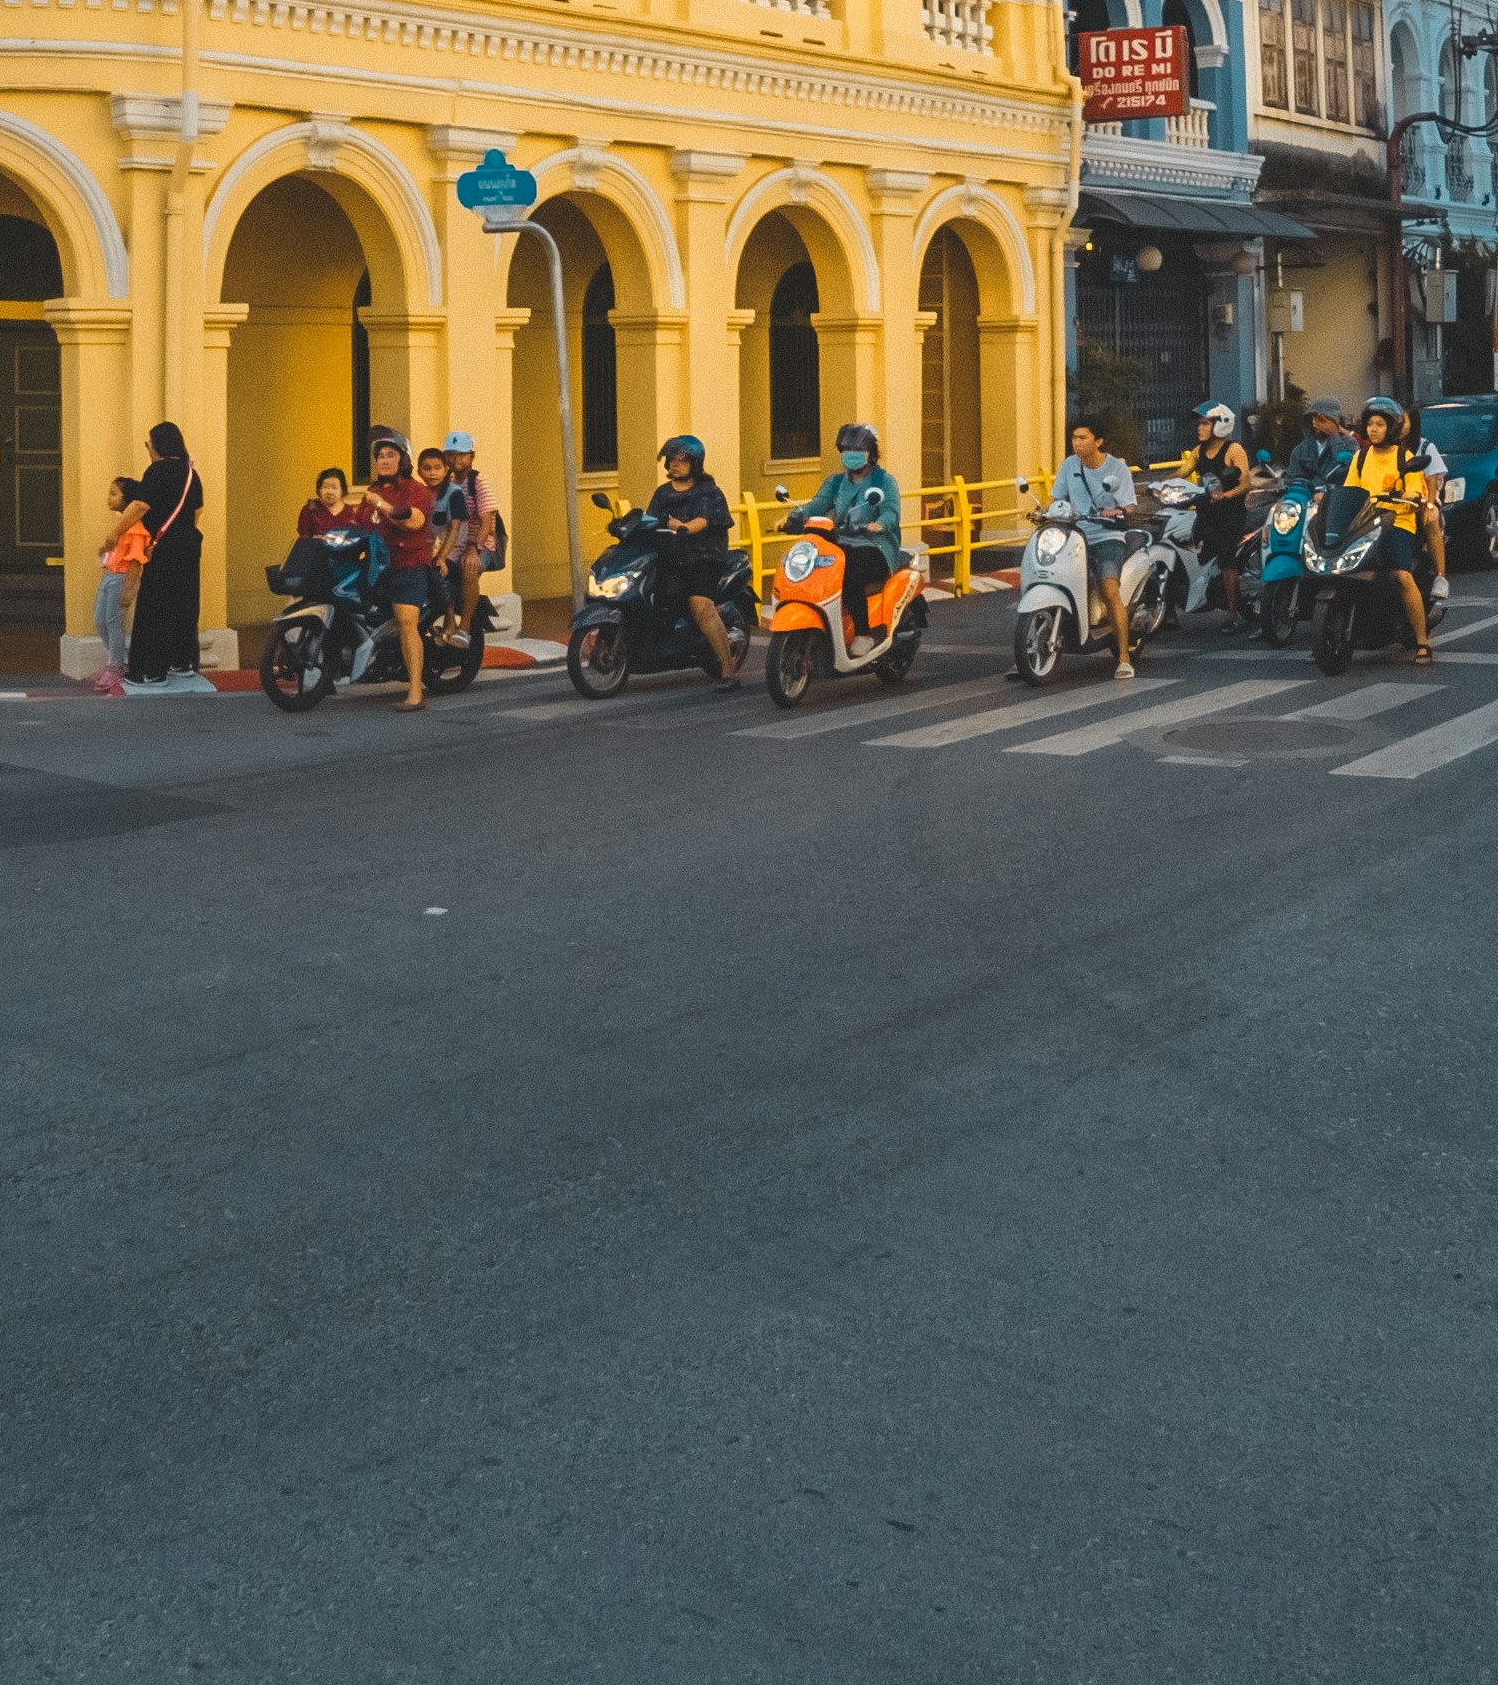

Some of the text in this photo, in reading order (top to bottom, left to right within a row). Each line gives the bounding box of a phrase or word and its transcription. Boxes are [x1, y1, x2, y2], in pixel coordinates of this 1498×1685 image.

[1092, 62, 1172, 79] DO RE MI
[1116, 94, 1167, 108] 215174
